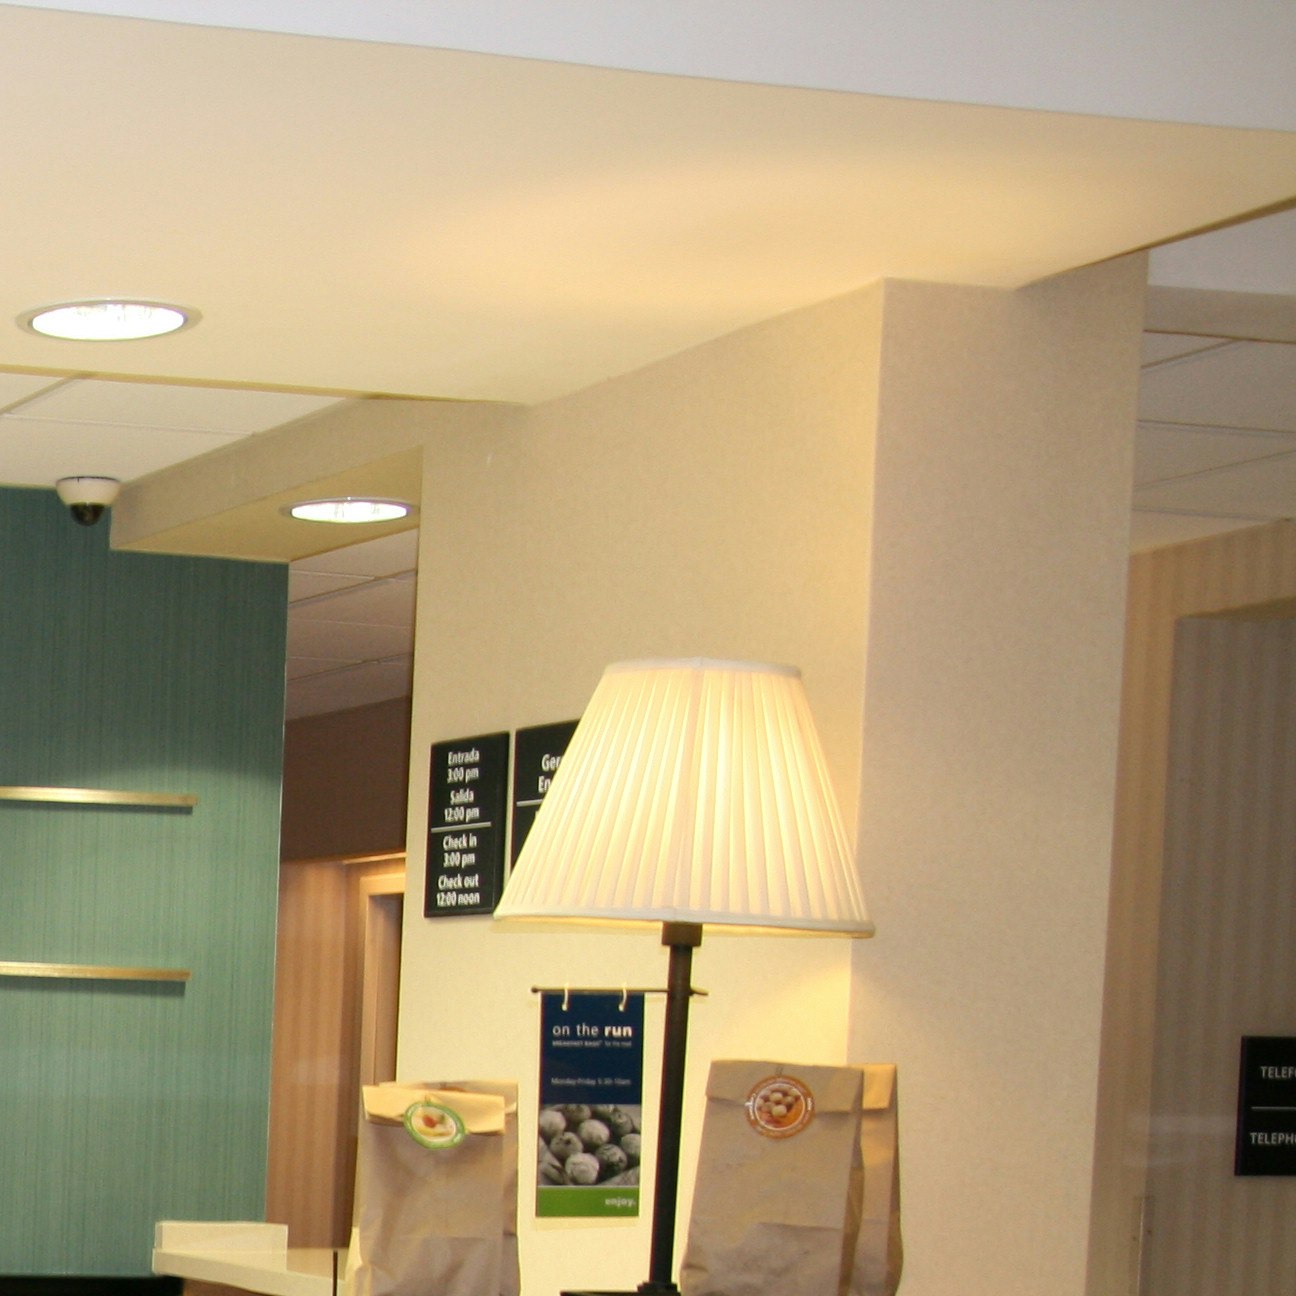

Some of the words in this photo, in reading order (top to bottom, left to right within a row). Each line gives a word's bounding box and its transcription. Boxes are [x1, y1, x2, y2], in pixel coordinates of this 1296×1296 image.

[448, 748, 480, 766] Entrada
[447, 767, 465, 784] 3:00
[465, 767, 479, 784] pm
[450, 788, 475, 805] Salida
[444, 806, 465, 823] 12:00
[465, 807, 480, 823] pm
[443, 832, 468, 851] Check
[469, 832, 478, 848] in
[442, 851, 461, 868] 3:00
[461, 853, 476, 869] pm
[438, 873, 463, 891] Check
[463, 873, 480, 888] out
[436, 891, 457, 907] 12:00
[457, 892, 481, 906] noon
[552, 1025, 570, 1036] on
[576, 1022, 599, 1036] the
[604, 1025, 633, 1037] run
[1260, 1066, 1296, 1078] TELEF
[1249, 1132, 1296, 1145] TELEPH
